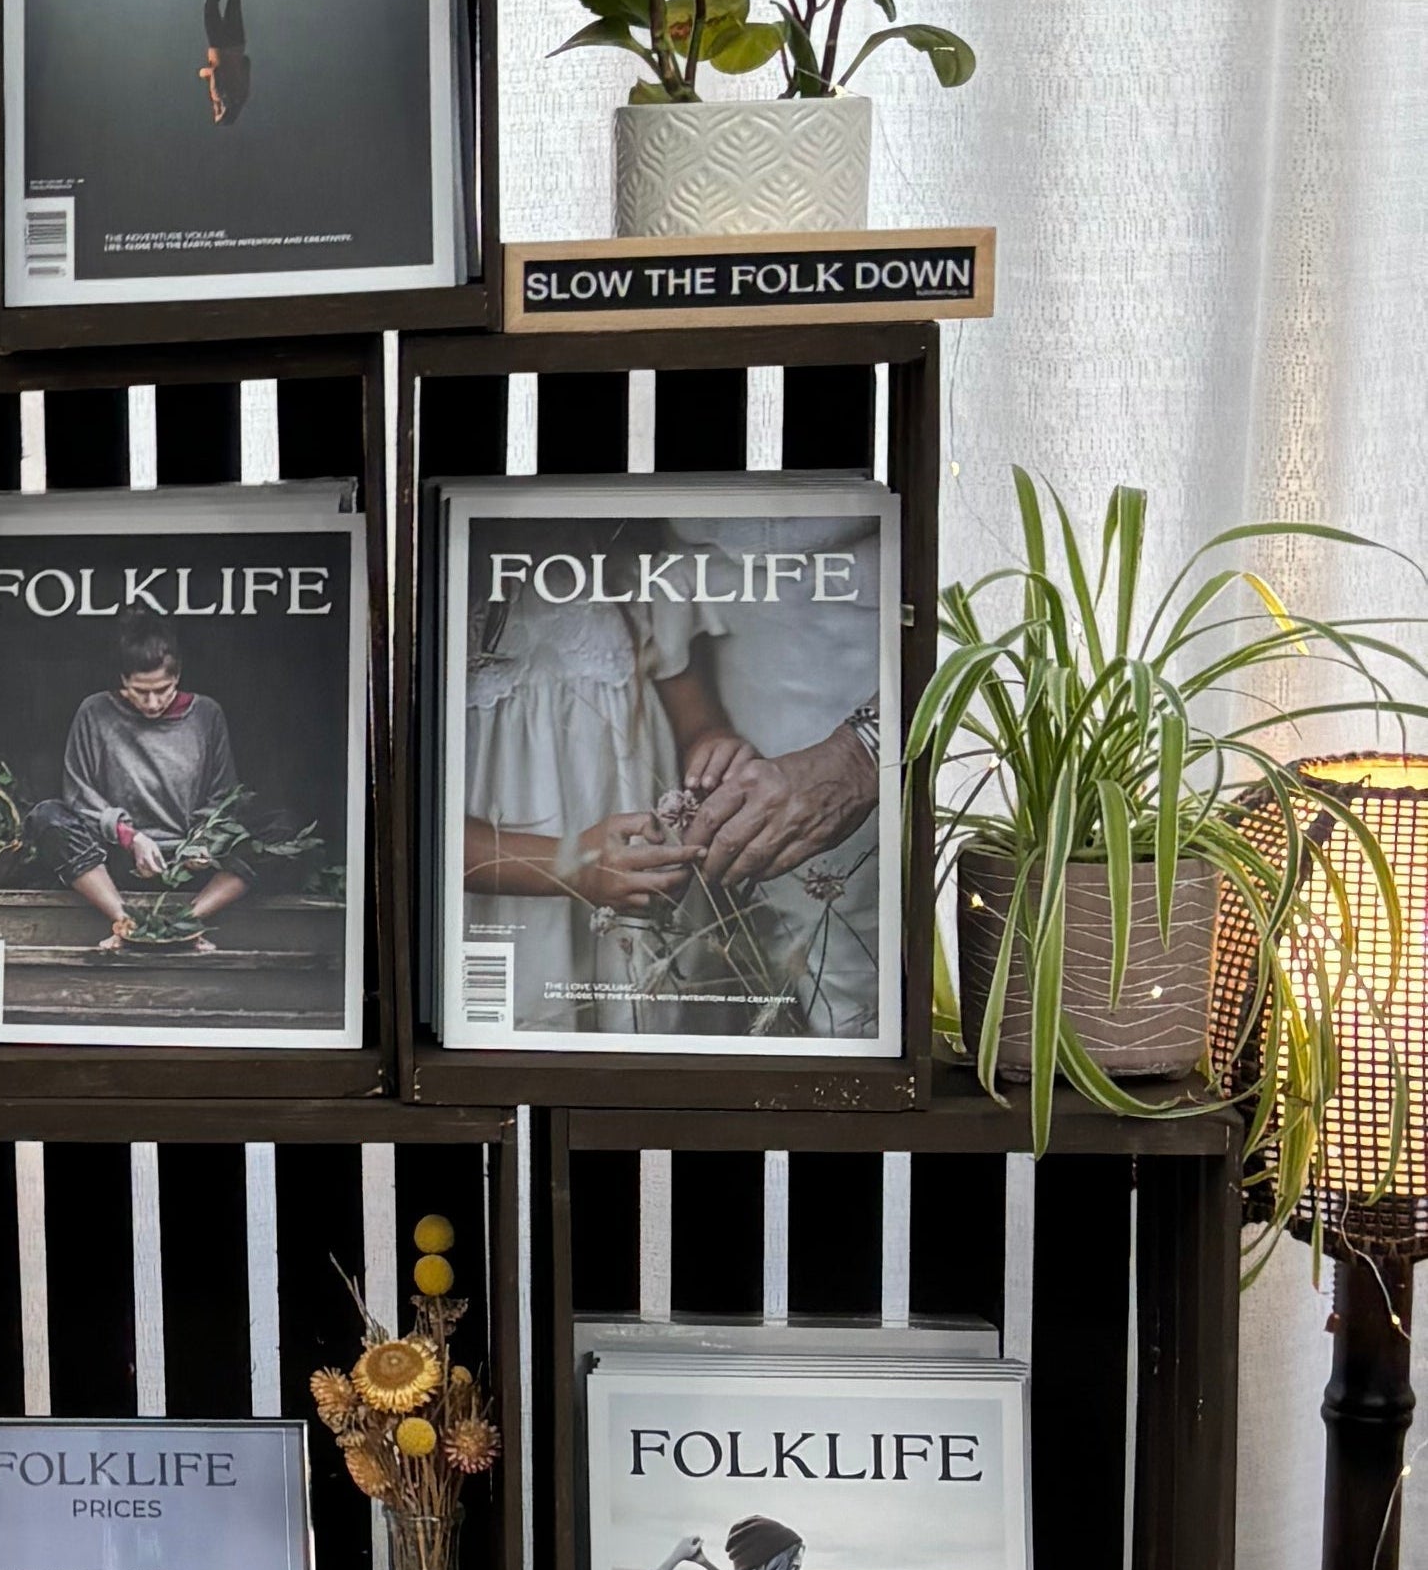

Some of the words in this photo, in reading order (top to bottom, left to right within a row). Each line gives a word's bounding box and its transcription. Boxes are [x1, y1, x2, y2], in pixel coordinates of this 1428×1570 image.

[105, 233, 123, 243] THE
[525, 269, 633, 302] SLOW
[644, 266, 717, 297] THE
[730, 261, 845, 296] FOLK
[855, 258, 970, 290] DOWN
[487, 552, 859, 604] FOLKLIFE
[544, 982, 562, 991] THE
[629, 1428, 984, 1482] FOLKLIFE
[73, 1498, 162, 1519] PRICES
